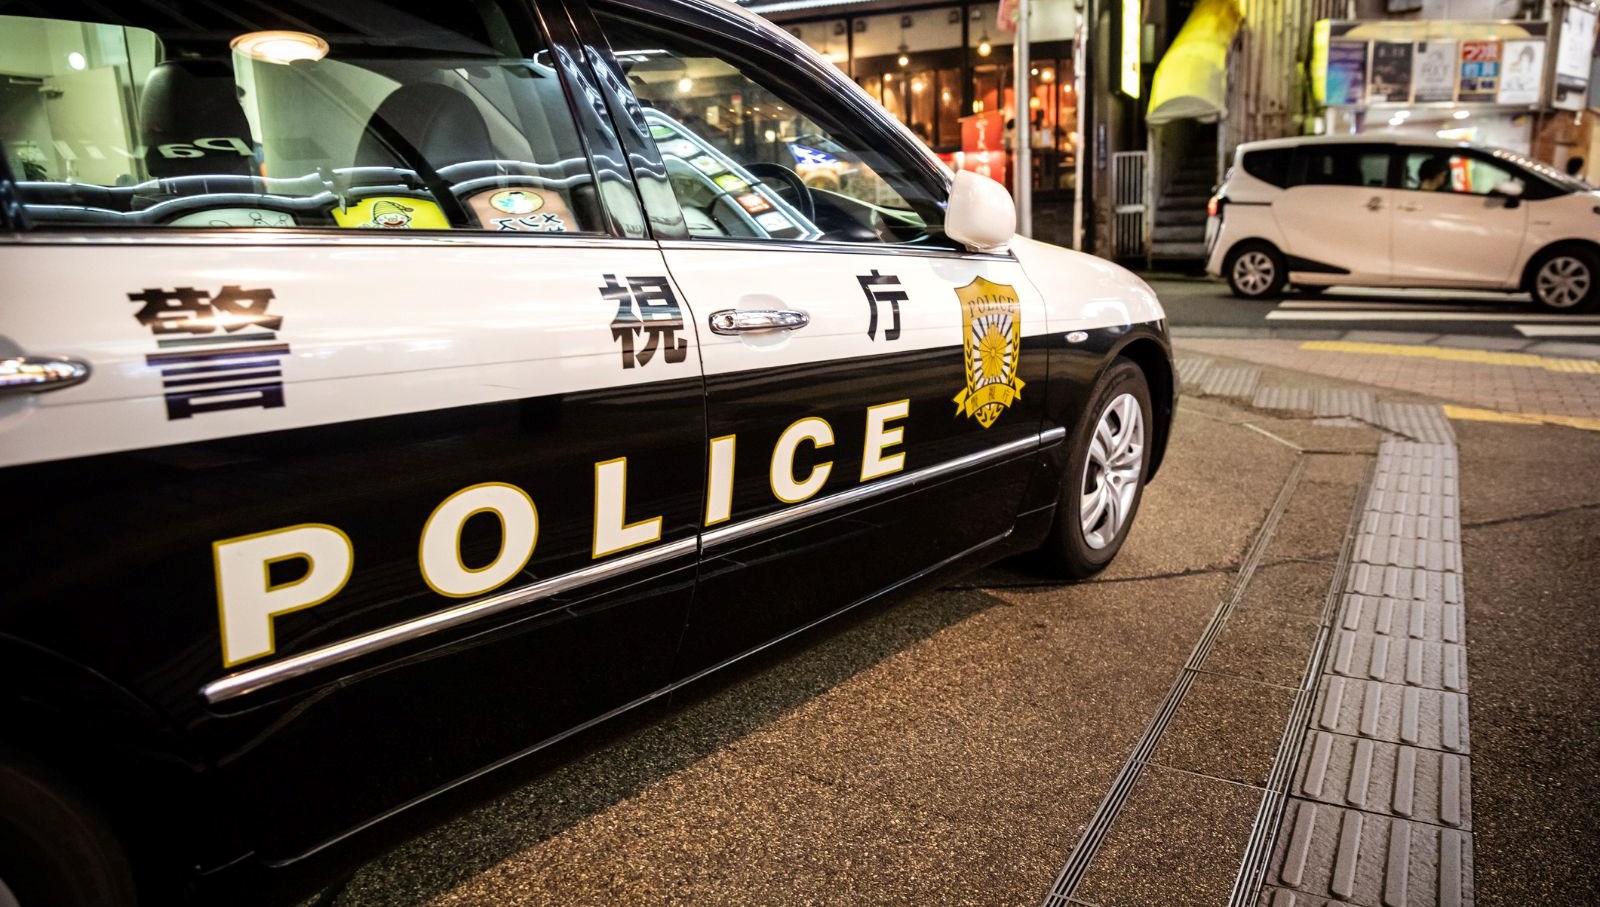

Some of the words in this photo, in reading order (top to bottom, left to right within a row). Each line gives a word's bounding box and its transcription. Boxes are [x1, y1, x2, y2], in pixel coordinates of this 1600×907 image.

[128, 269, 909, 420] 警視庁
[967, 294, 1016, 319] POLICE
[212, 399, 910, 668] POLICE
